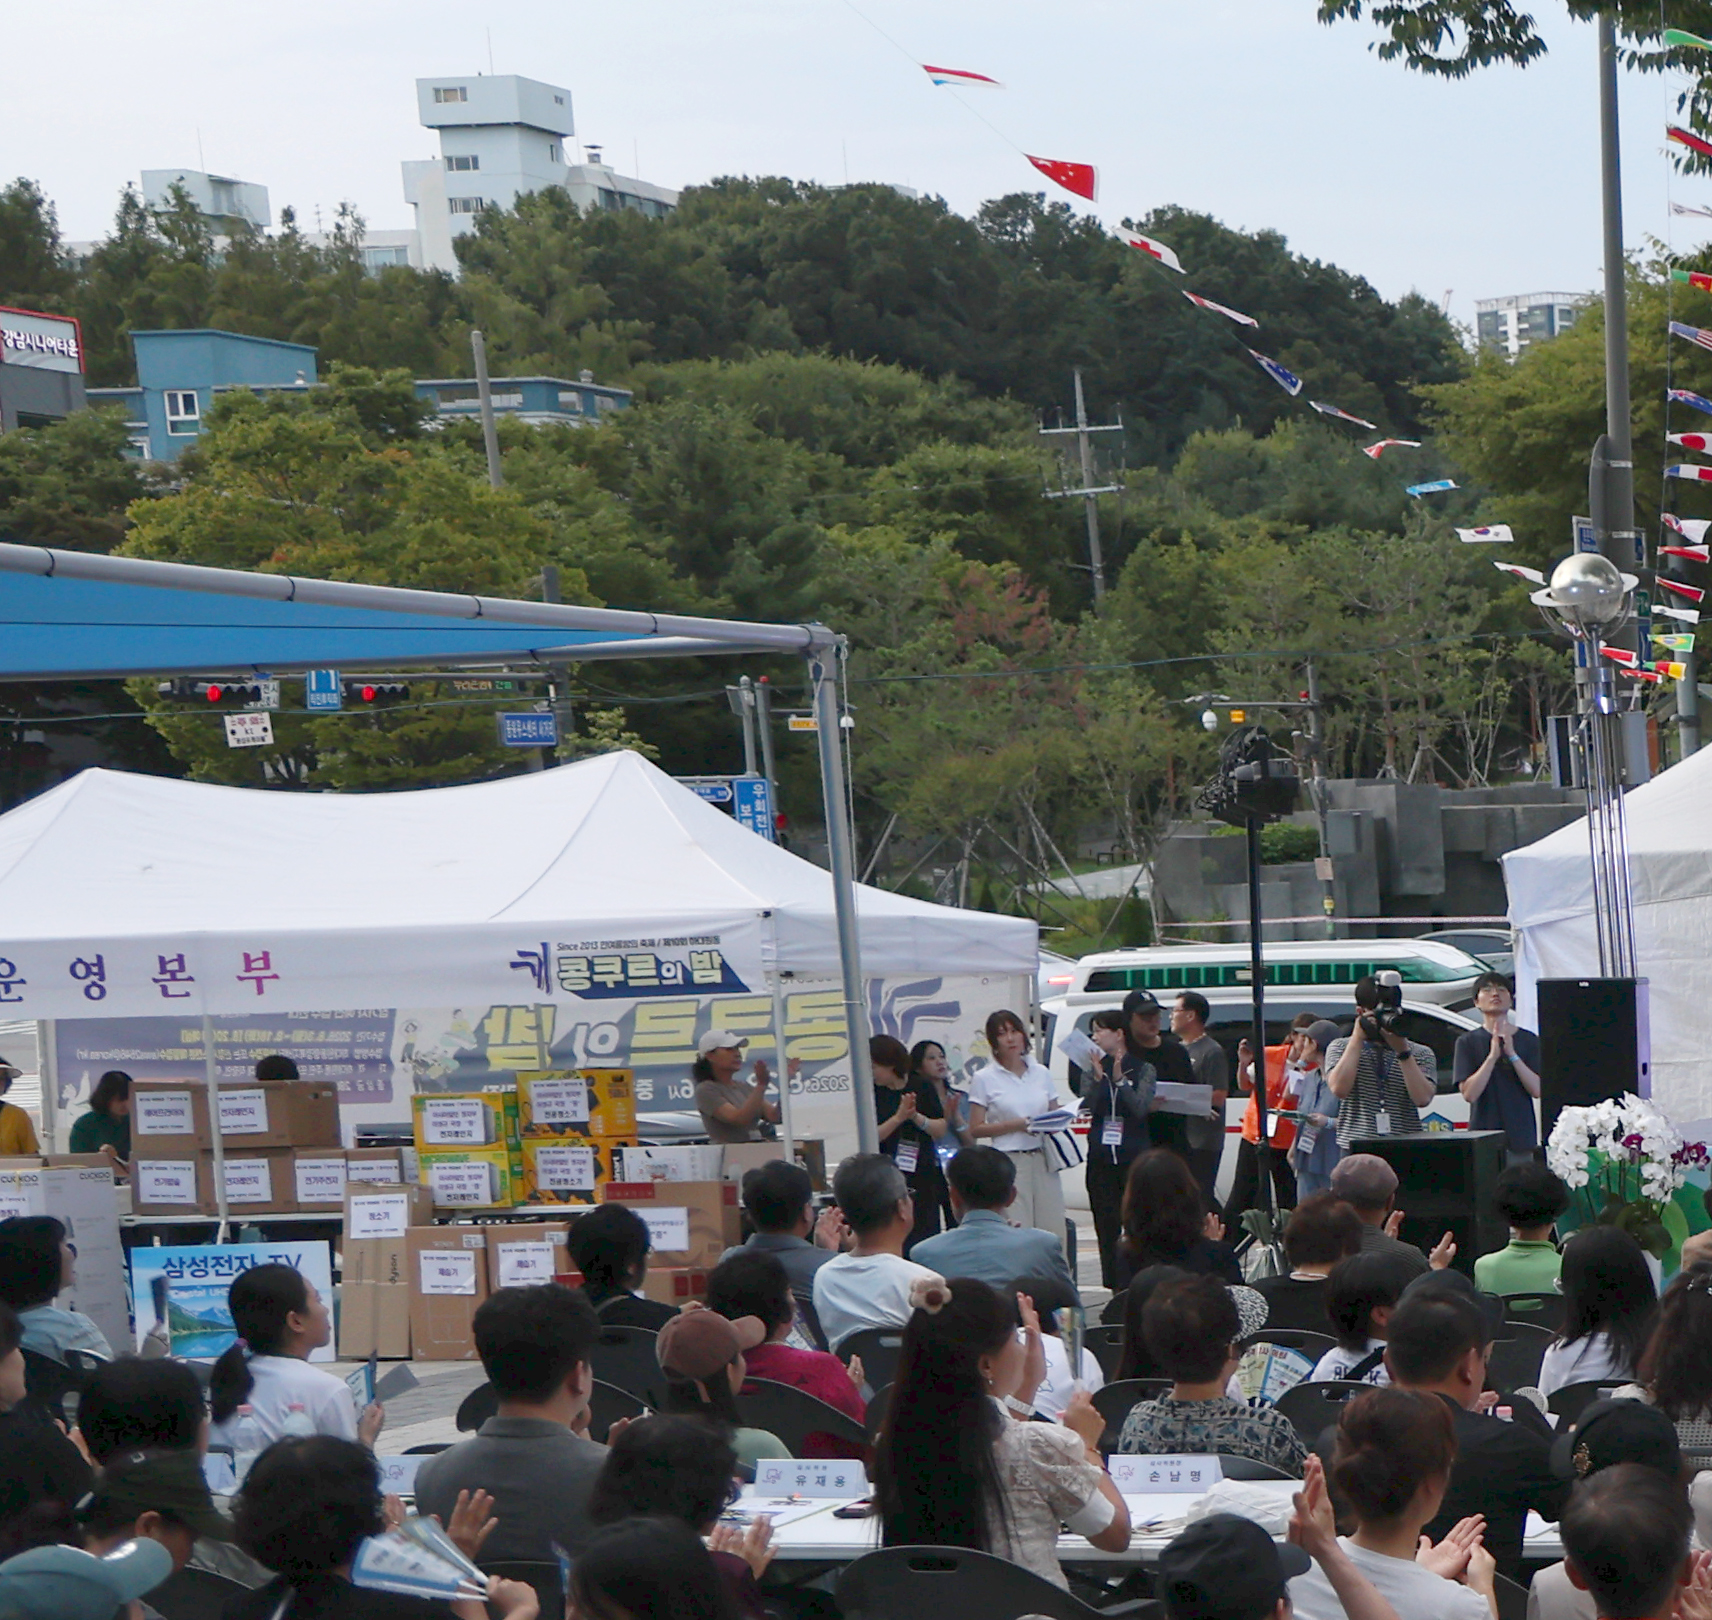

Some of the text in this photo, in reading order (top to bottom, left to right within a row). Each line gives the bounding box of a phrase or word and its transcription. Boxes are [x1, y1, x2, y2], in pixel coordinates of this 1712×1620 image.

[557, 942, 578, 951] Since
[580, 941, 598, 950] 2013
[69, 953, 107, 1001] 영
[152, 952, 195, 999] 본
[236, 950, 281, 996] 부
[557, 953, 685, 991] 콩쿠르의
[689, 950, 724, 984] 밤
[162, 1254, 259, 1279] 삼성전자
